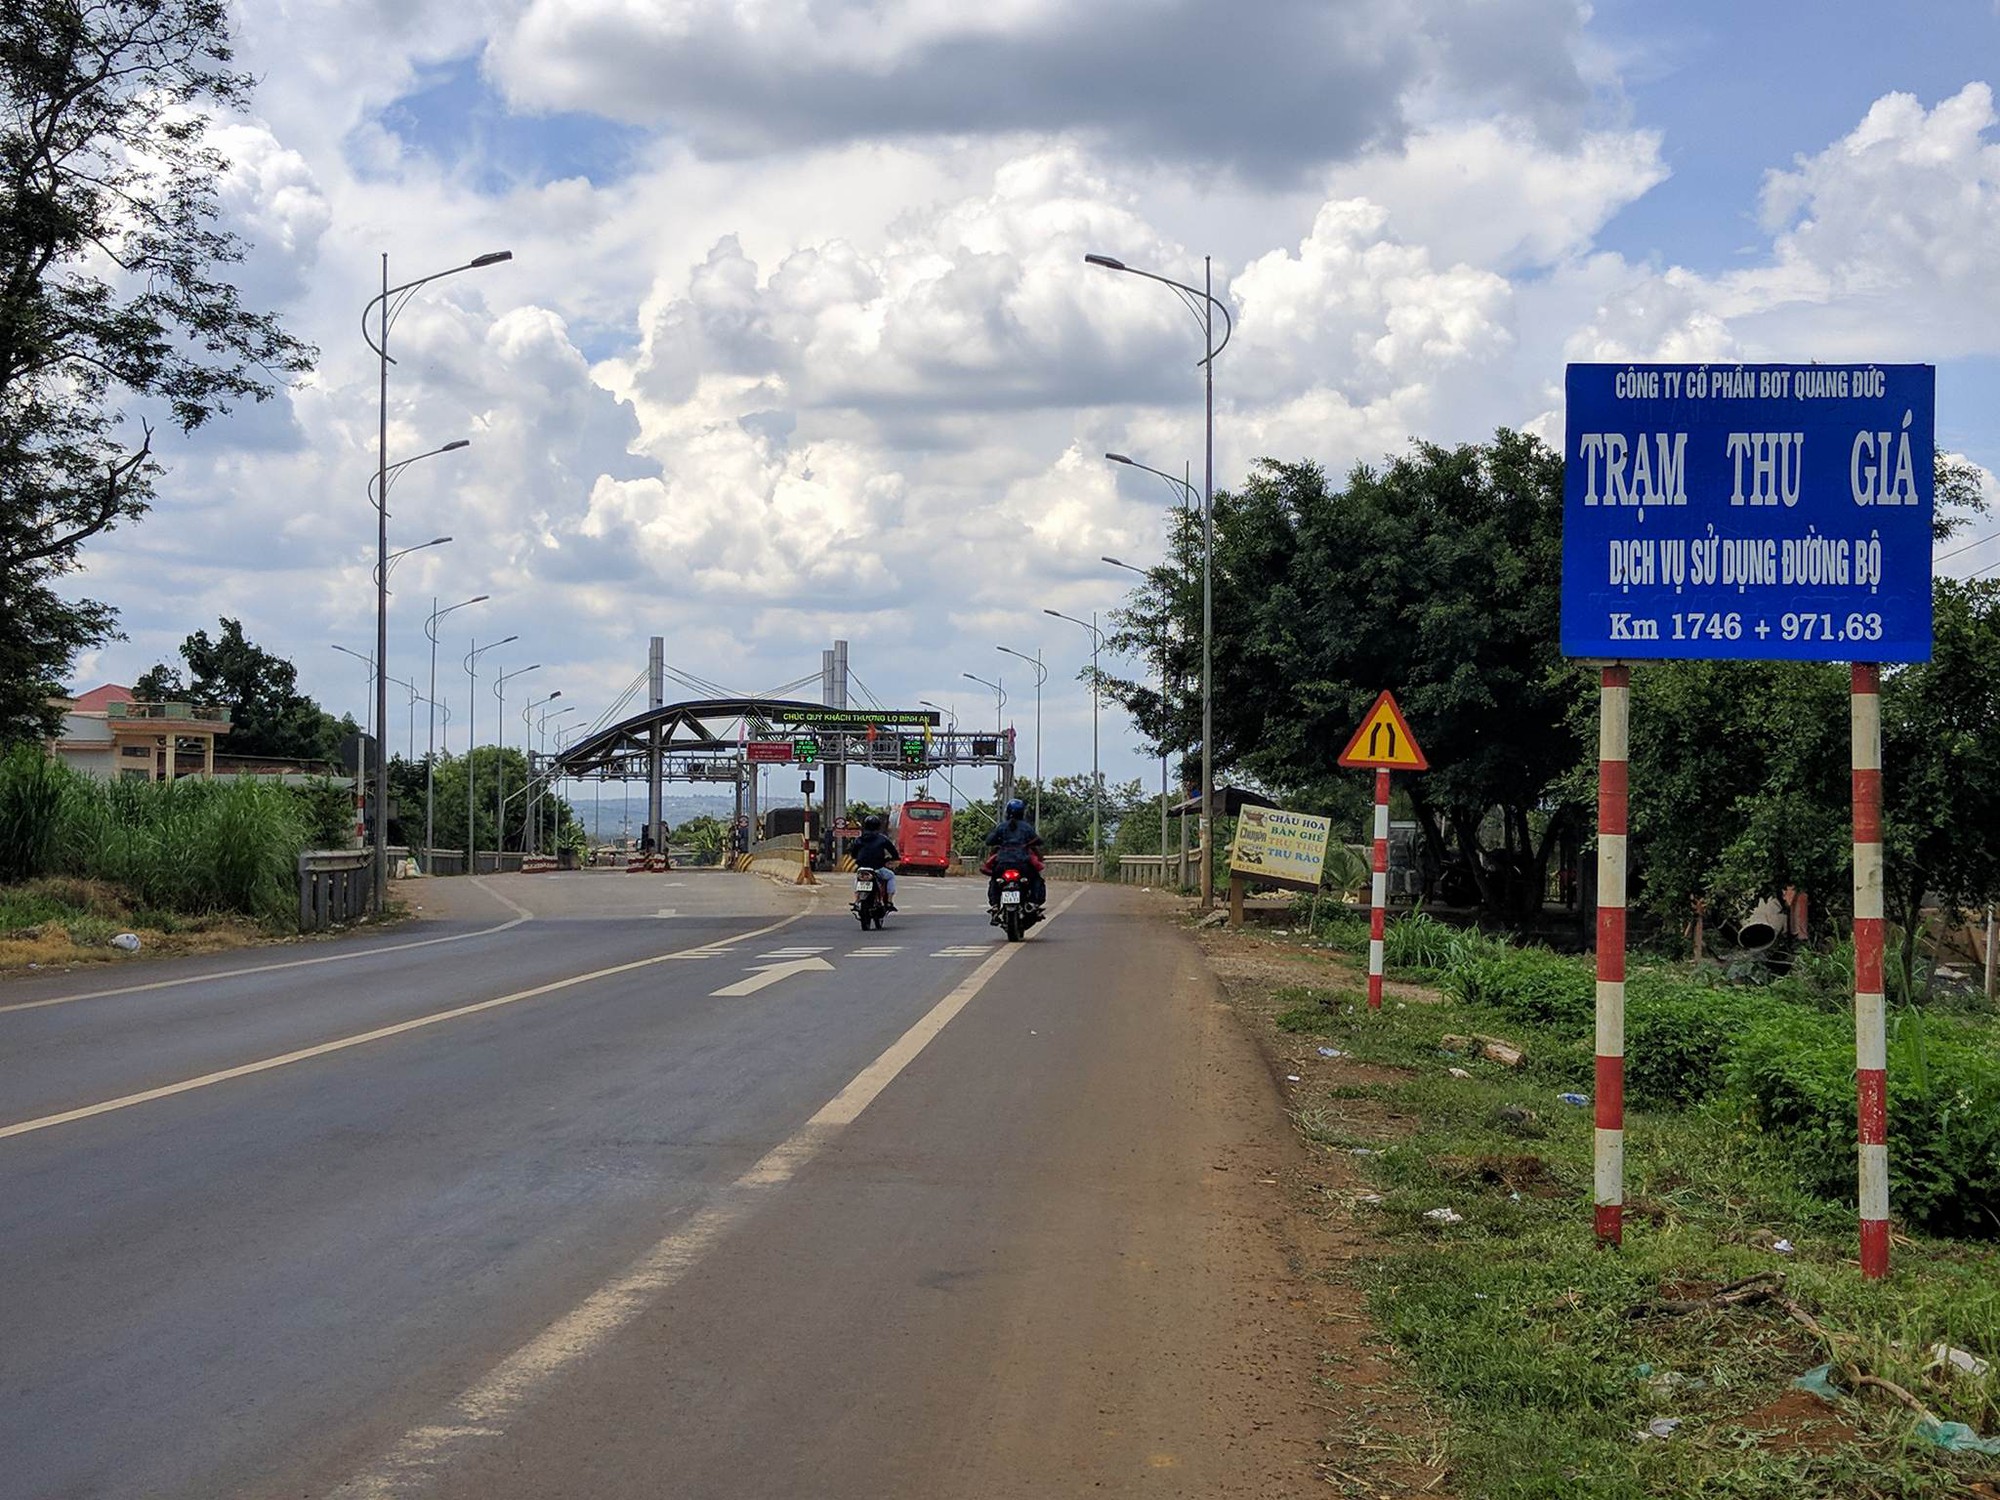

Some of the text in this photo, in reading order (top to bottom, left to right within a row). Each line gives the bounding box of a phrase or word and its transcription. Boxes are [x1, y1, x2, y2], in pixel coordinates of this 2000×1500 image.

[1615, 364, 1886, 401] CÔNG TY CỔ PHẦN BOT QUANG ĐỨC
[1579, 408, 1919, 523] TRẠM THU GIÁ
[1609, 523, 1881, 594] DỊCH VỤ SỬ DỤNG ĐƯỜNG BỘ
[1609, 612, 1883, 642] Km 1746 + 971,63
[1302, 819, 1326, 830] HOA
